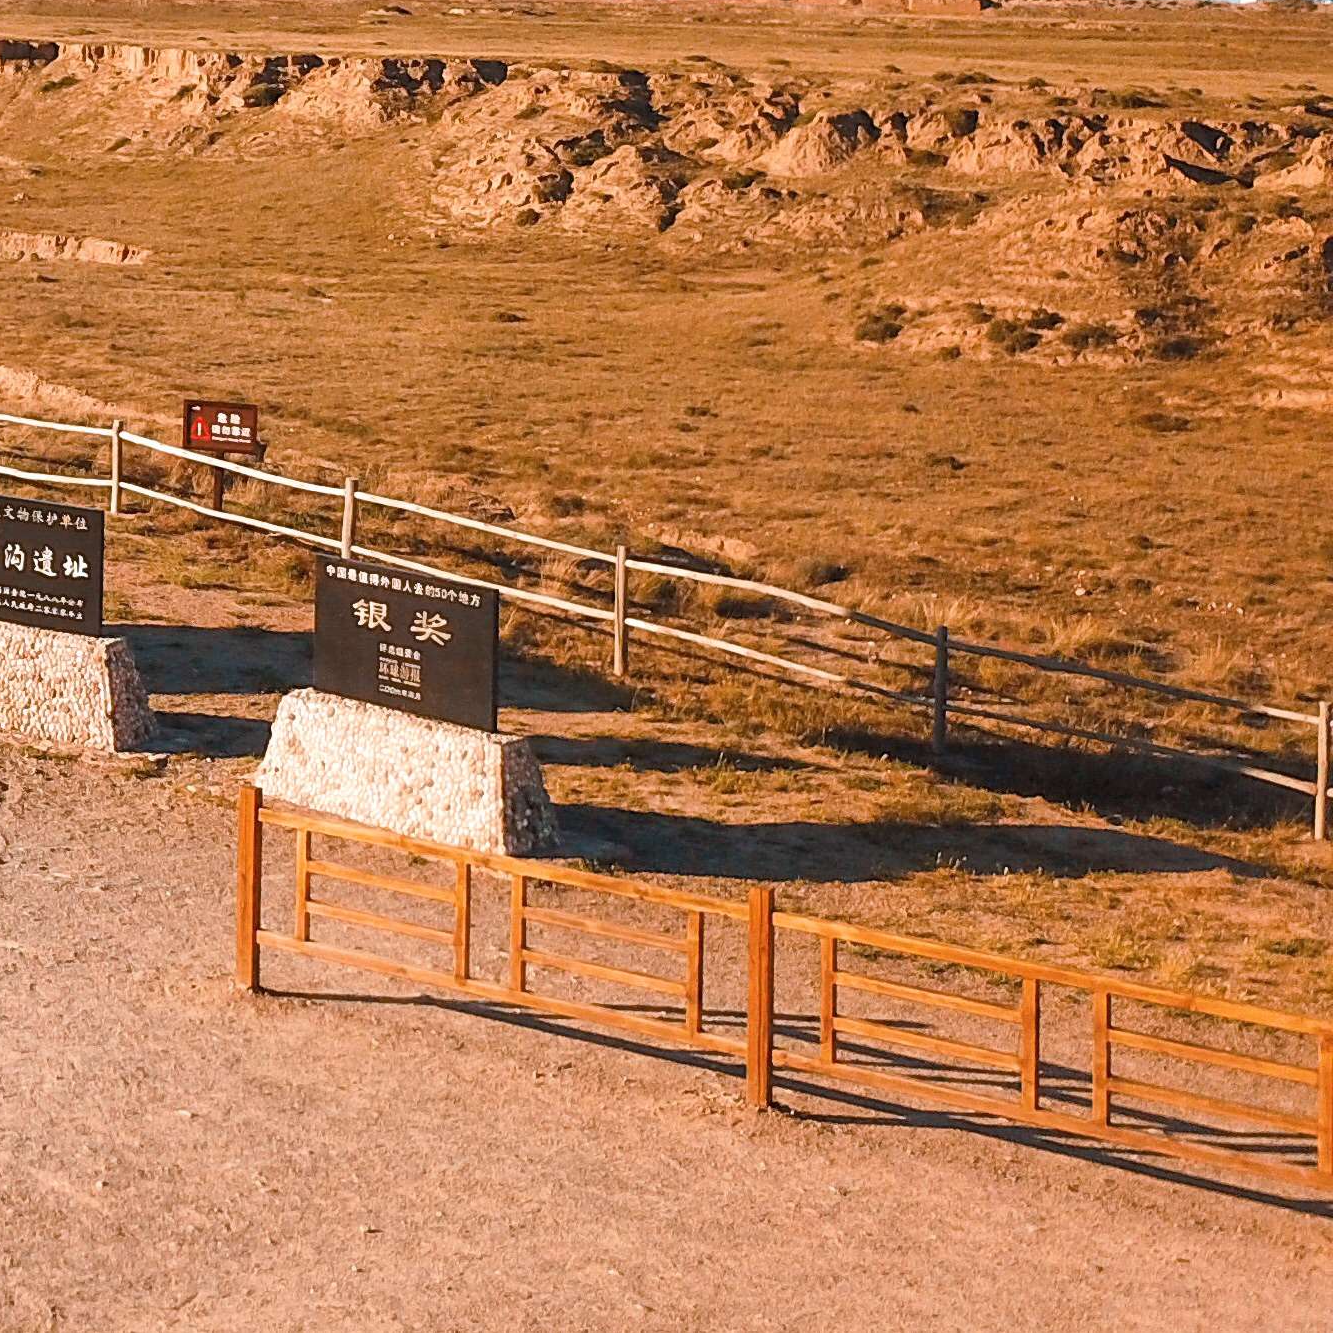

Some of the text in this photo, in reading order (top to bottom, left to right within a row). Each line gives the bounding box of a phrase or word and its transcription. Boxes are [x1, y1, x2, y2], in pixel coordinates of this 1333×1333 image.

[326, 564, 481, 608] 中国最值得外国人去的50个地方
[352, 599, 452, 646] 银奖
